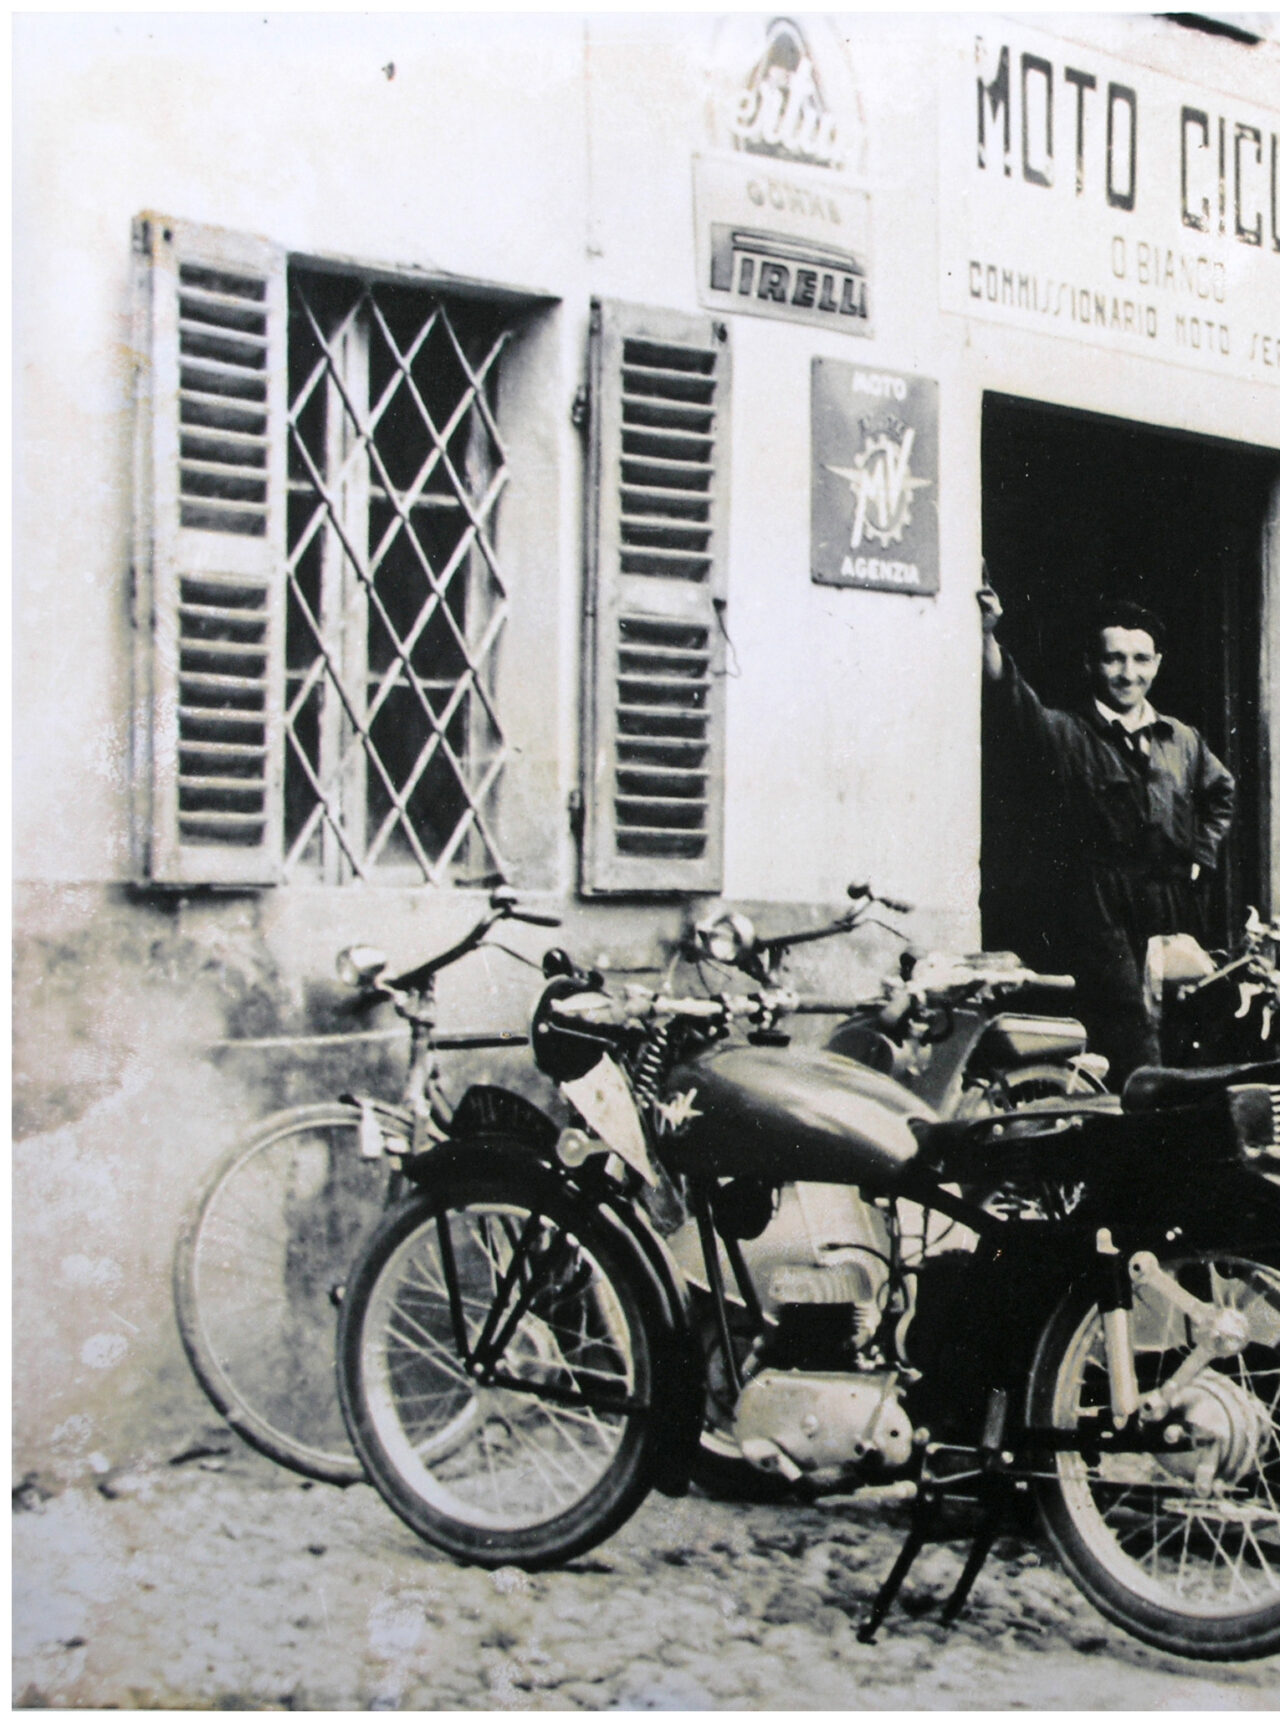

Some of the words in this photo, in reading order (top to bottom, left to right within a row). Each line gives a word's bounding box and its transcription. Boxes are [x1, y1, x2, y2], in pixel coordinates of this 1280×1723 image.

[976, 36, 1137, 212] MOTO
[710, 222, 868, 319] PIRELLI
[969, 260, 1158, 340] COMMISSIONARIO
[1176, 314, 1230, 355] MOTO
[1138, 241, 1226, 304] BIANCO
[852, 370, 908, 401] MOTO
[840, 554, 921, 585] AGENZIA
